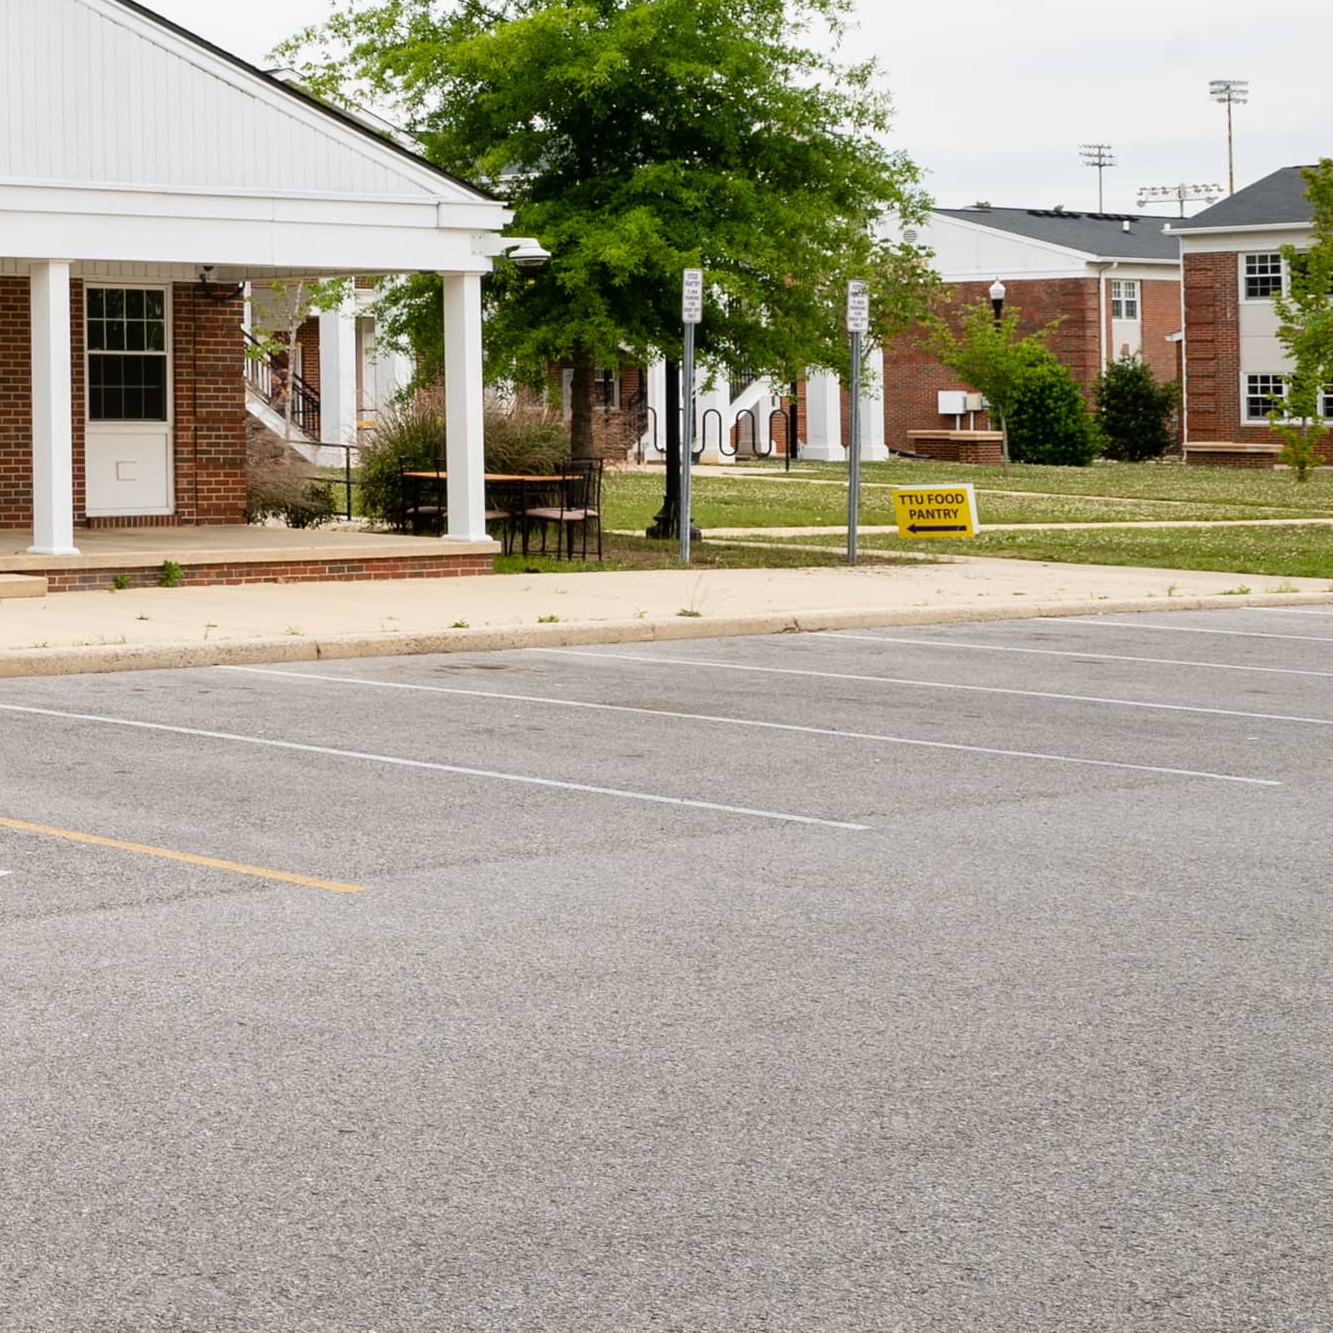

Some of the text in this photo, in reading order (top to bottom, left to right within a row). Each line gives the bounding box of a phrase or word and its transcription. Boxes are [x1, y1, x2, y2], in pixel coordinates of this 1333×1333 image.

[898, 494, 965, 505] TTU FOOD
[909, 508, 959, 520] PANTRY
